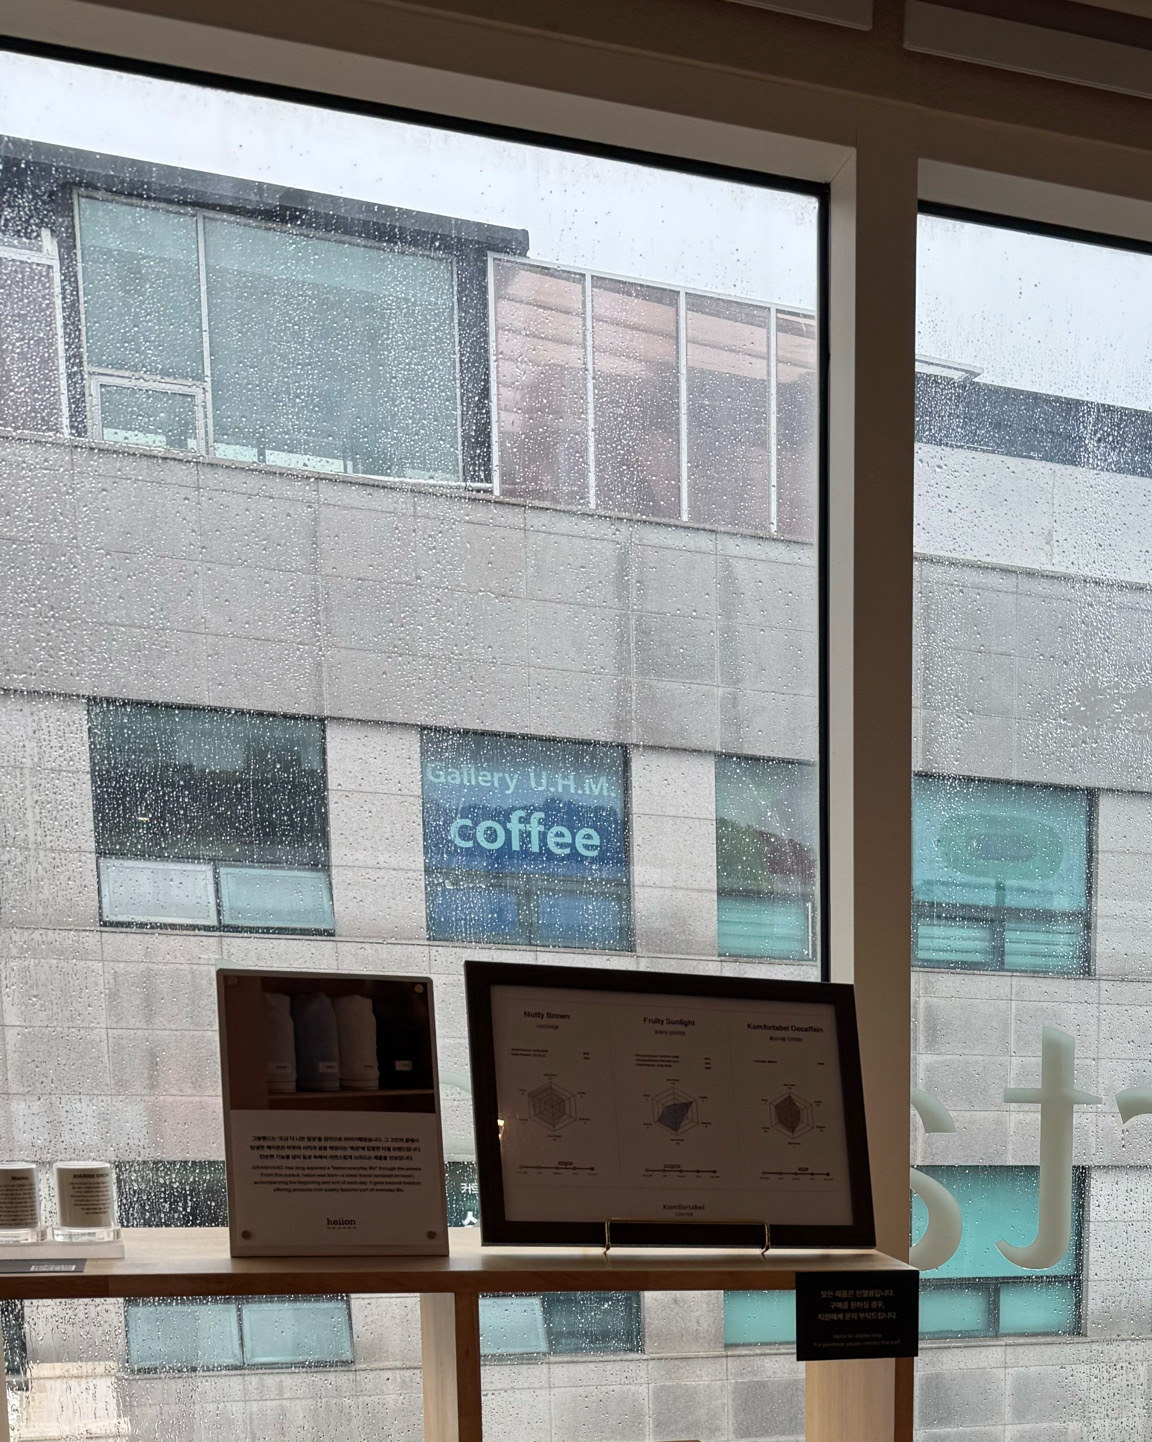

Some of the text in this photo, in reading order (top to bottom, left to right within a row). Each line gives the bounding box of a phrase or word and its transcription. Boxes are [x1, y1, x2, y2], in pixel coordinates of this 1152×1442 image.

[427, 762, 518, 795] Gallery
[449, 809, 601, 857] coffee
[523, 1010, 571, 1020] Nutty Brown
[665, 1017, 696, 1028] Sunlight
